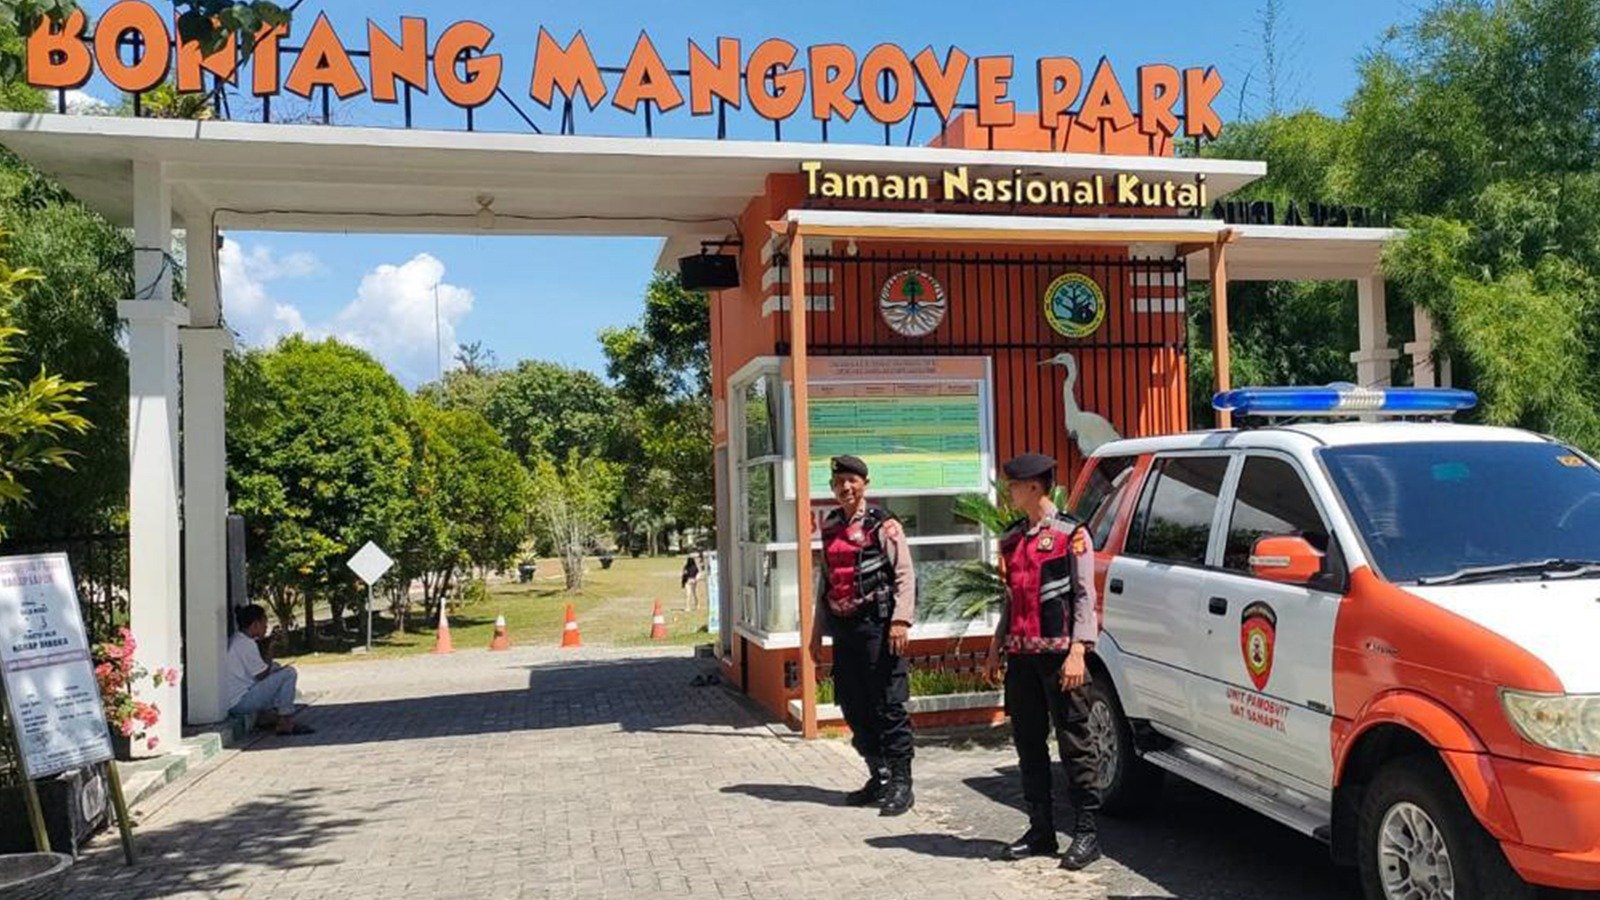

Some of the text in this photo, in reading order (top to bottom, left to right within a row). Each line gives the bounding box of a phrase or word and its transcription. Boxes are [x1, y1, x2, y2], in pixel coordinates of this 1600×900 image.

[27, 0, 1223, 141] BONTANG MANGROVE PARK
[802, 161, 1207, 207] Taman Nasional Kutai
